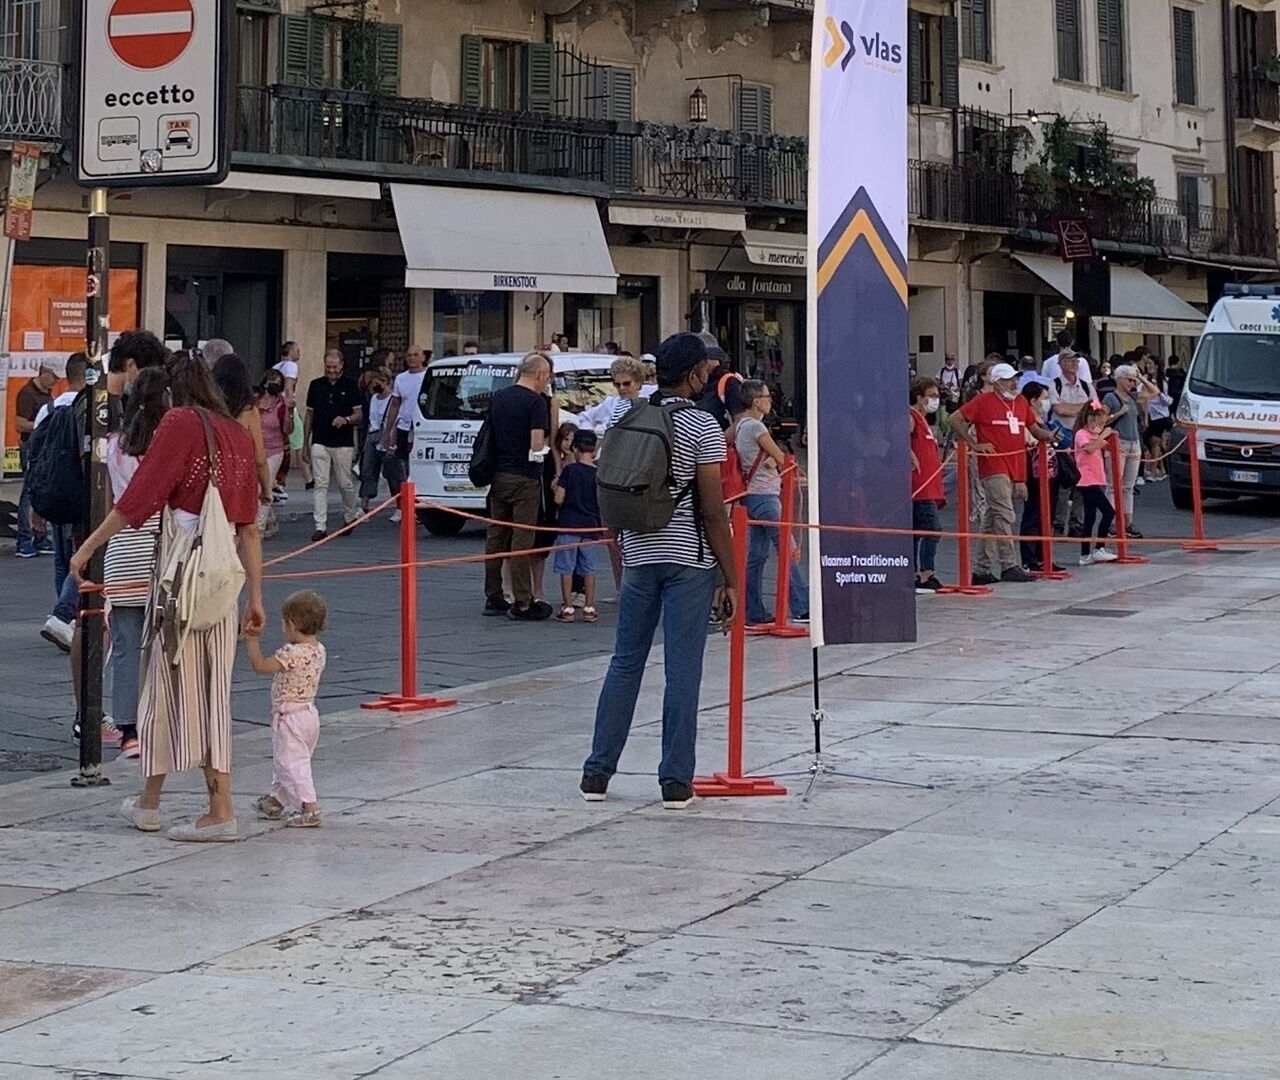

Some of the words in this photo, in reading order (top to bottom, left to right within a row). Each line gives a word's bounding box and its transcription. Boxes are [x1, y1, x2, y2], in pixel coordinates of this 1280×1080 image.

[860, 32, 903, 64] vlas
[104, 83, 196, 108] eccetto
[168, 120, 190, 129] TAXI
[768, 252, 805, 265] merceria
[493, 275, 538, 288] BIRKENSTOCK
[726, 275, 746, 292] alla
[751, 276, 793, 295] fontana
[1239, 323, 1262, 331] CROCE
[448, 463, 458, 473] FS
[821, 556, 852, 568] Vlaamse
[852, 554, 909, 568] Traditionele
[836, 572, 866, 586] Sporten
[867, 573, 887, 583] vzw
